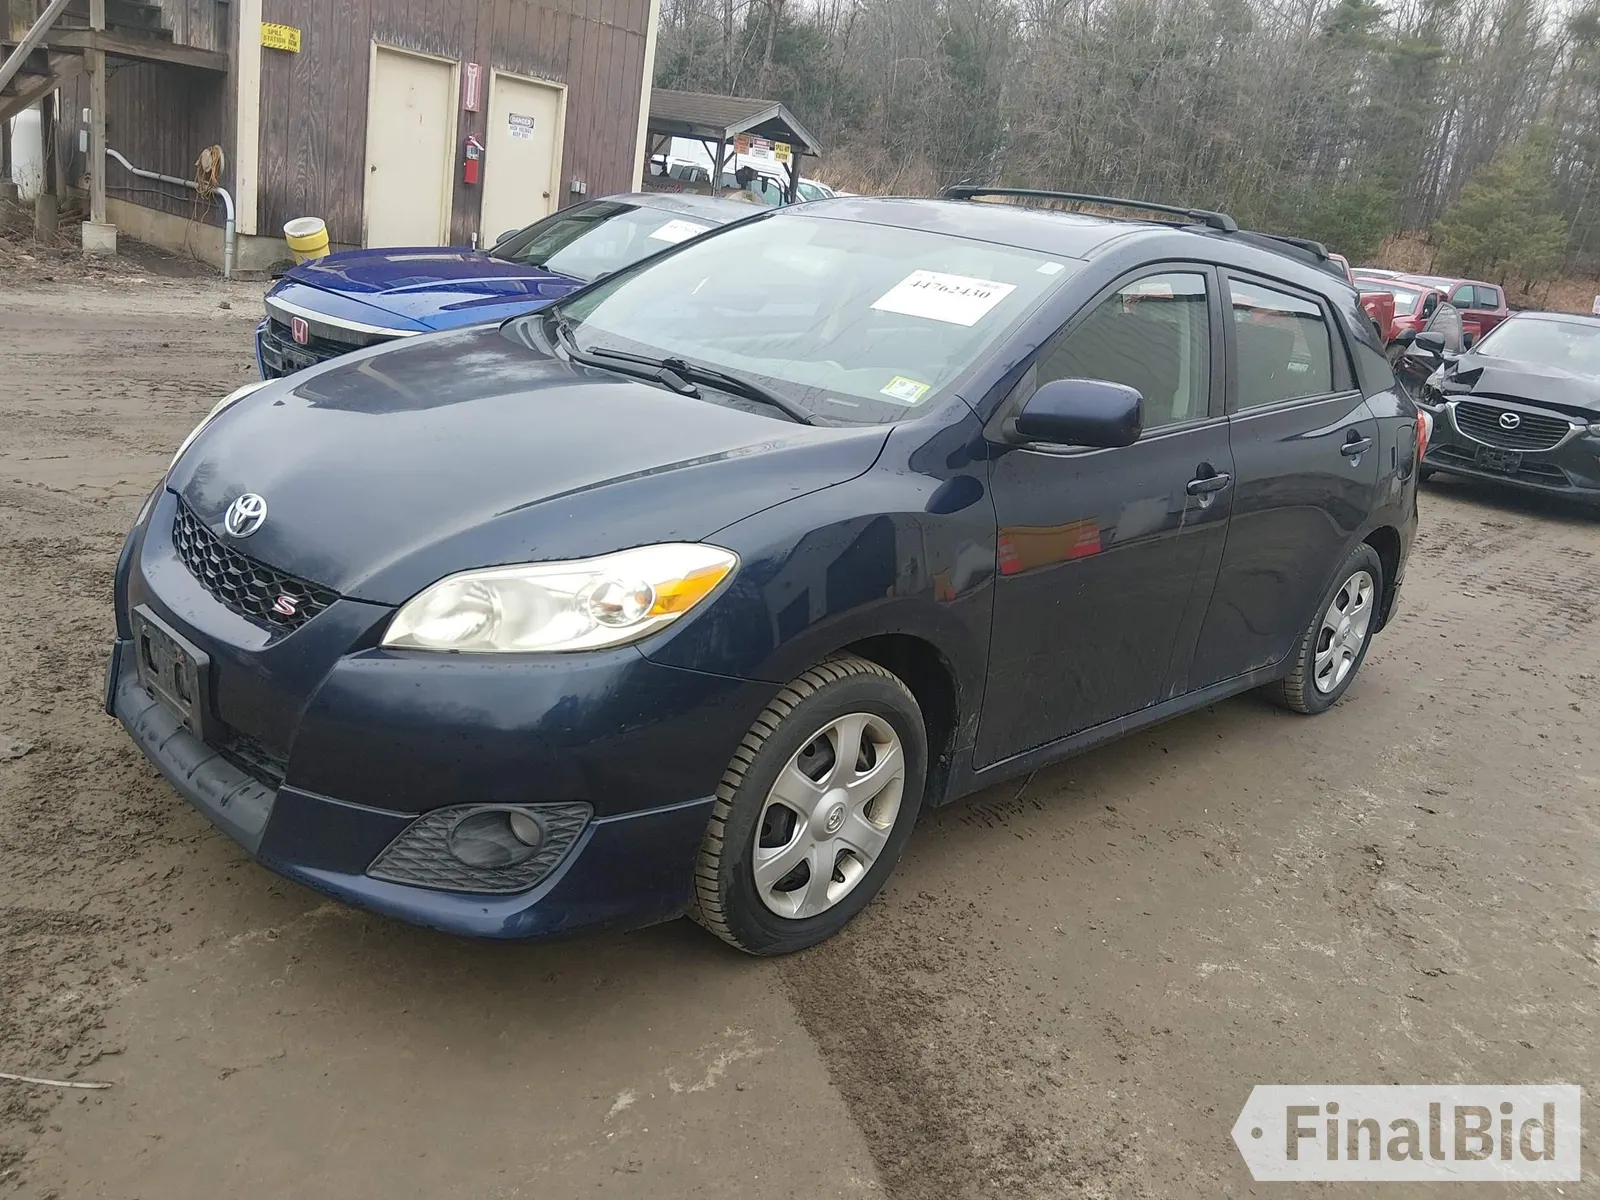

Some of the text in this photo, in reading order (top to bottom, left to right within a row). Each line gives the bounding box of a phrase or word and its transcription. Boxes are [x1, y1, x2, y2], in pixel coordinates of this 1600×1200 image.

[267, 28, 283, 37] SPILL
[263, 34, 286, 45] STATION
[511, 115, 533, 127] DANGER
[272, 595, 299, 616] S
